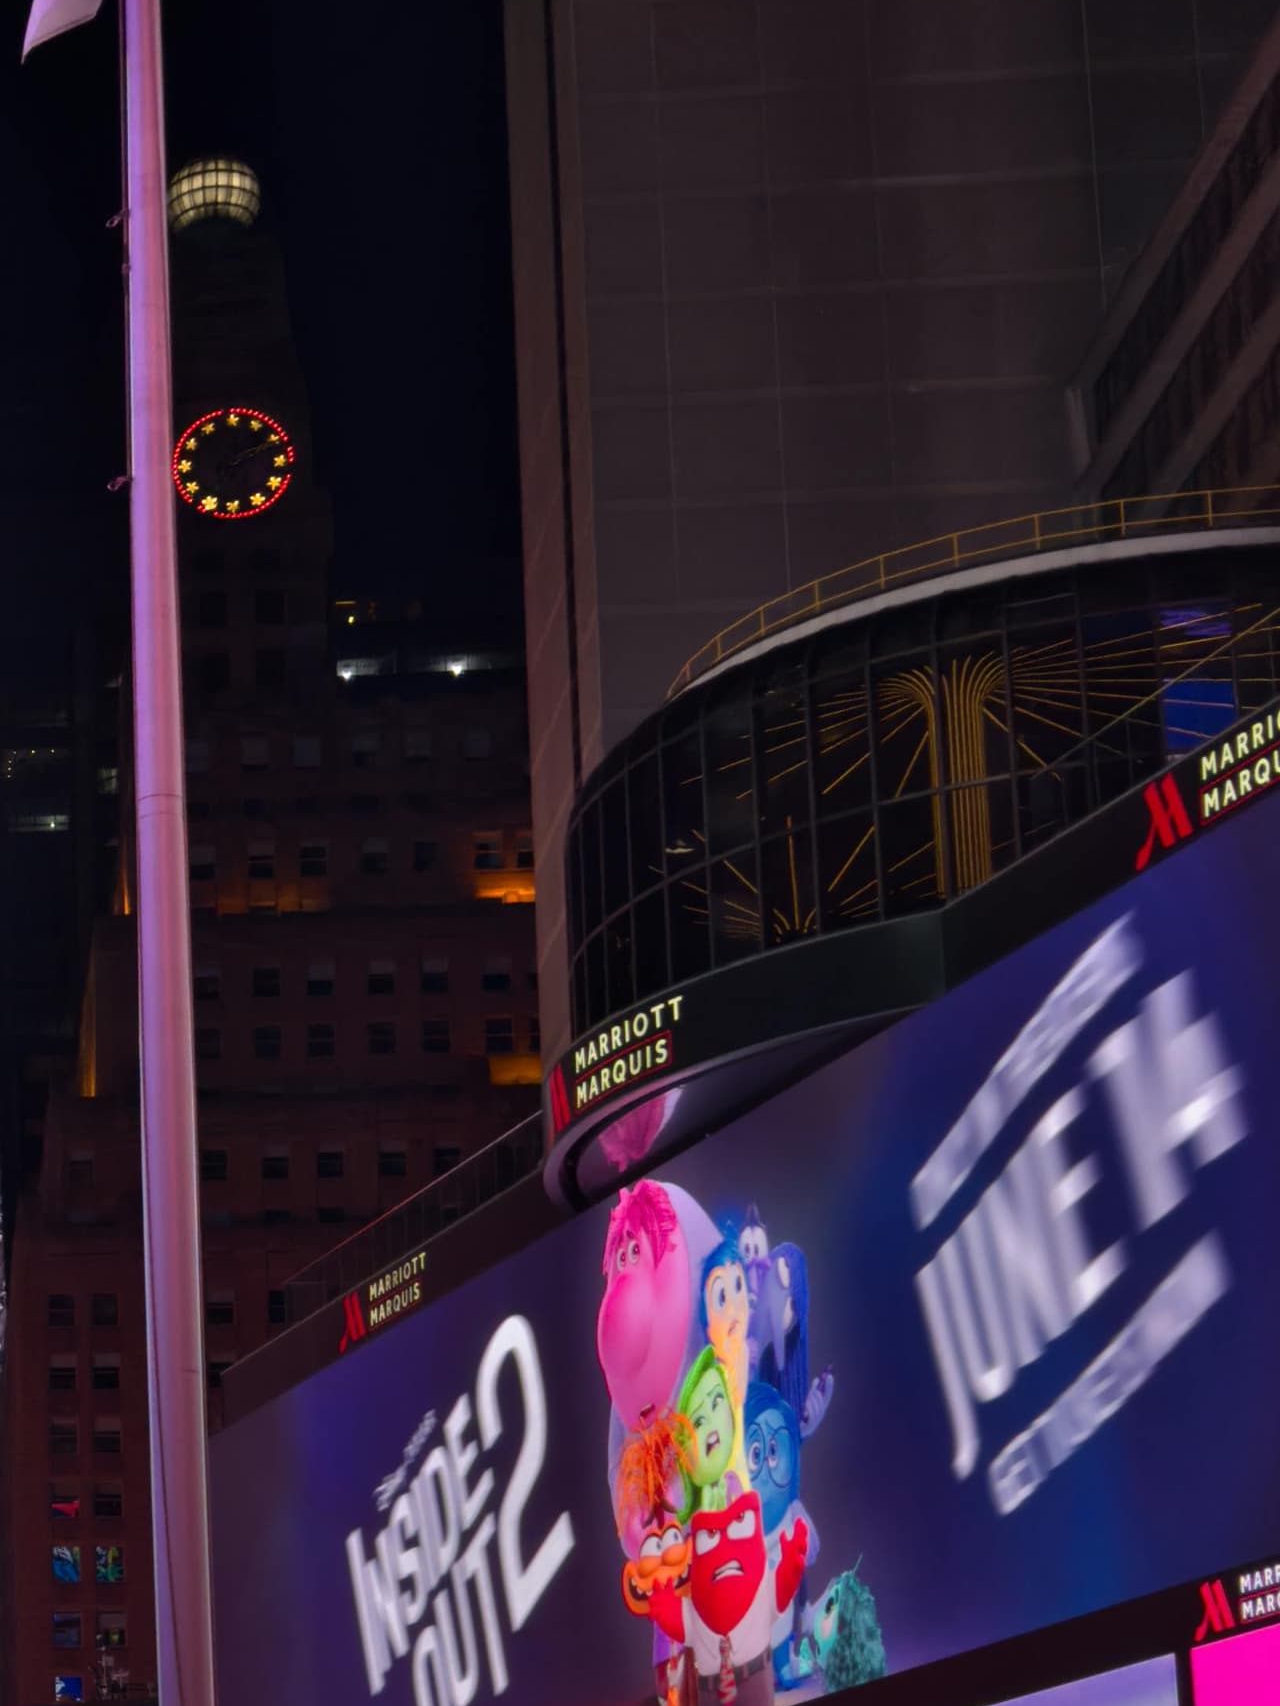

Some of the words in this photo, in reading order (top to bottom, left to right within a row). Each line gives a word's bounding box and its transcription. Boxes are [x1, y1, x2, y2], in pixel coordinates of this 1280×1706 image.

[573, 995, 685, 1073] MARRIOTT
[575, 1037, 670, 1109] MARQUIS
[369, 1252, 426, 1302] MARRIOTT
[370, 1282, 421, 1326] MARQUIS
[916, 1083, 1131, 1482] JUNE
[476, 1313, 576, 1634] 2
[346, 1392, 495, 1697] INSIDE
